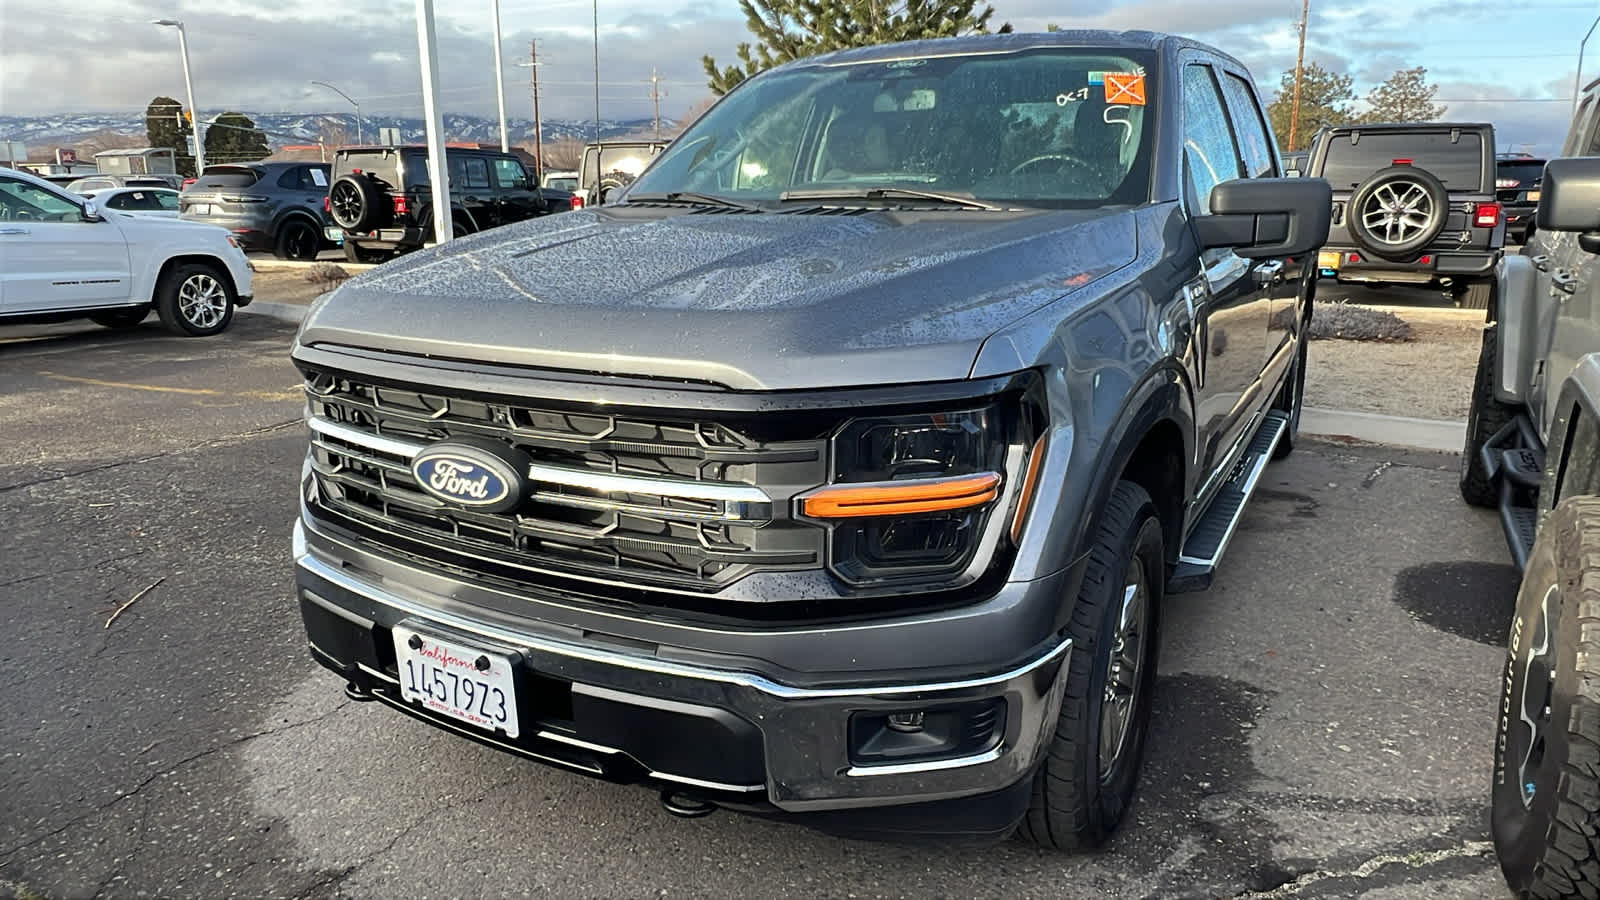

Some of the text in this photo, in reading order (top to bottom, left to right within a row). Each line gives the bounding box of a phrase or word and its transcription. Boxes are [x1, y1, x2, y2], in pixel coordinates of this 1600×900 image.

[430, 460, 489, 499] Ford
[419, 640, 484, 673] Californi
[406, 659, 507, 723] 14579Z3
